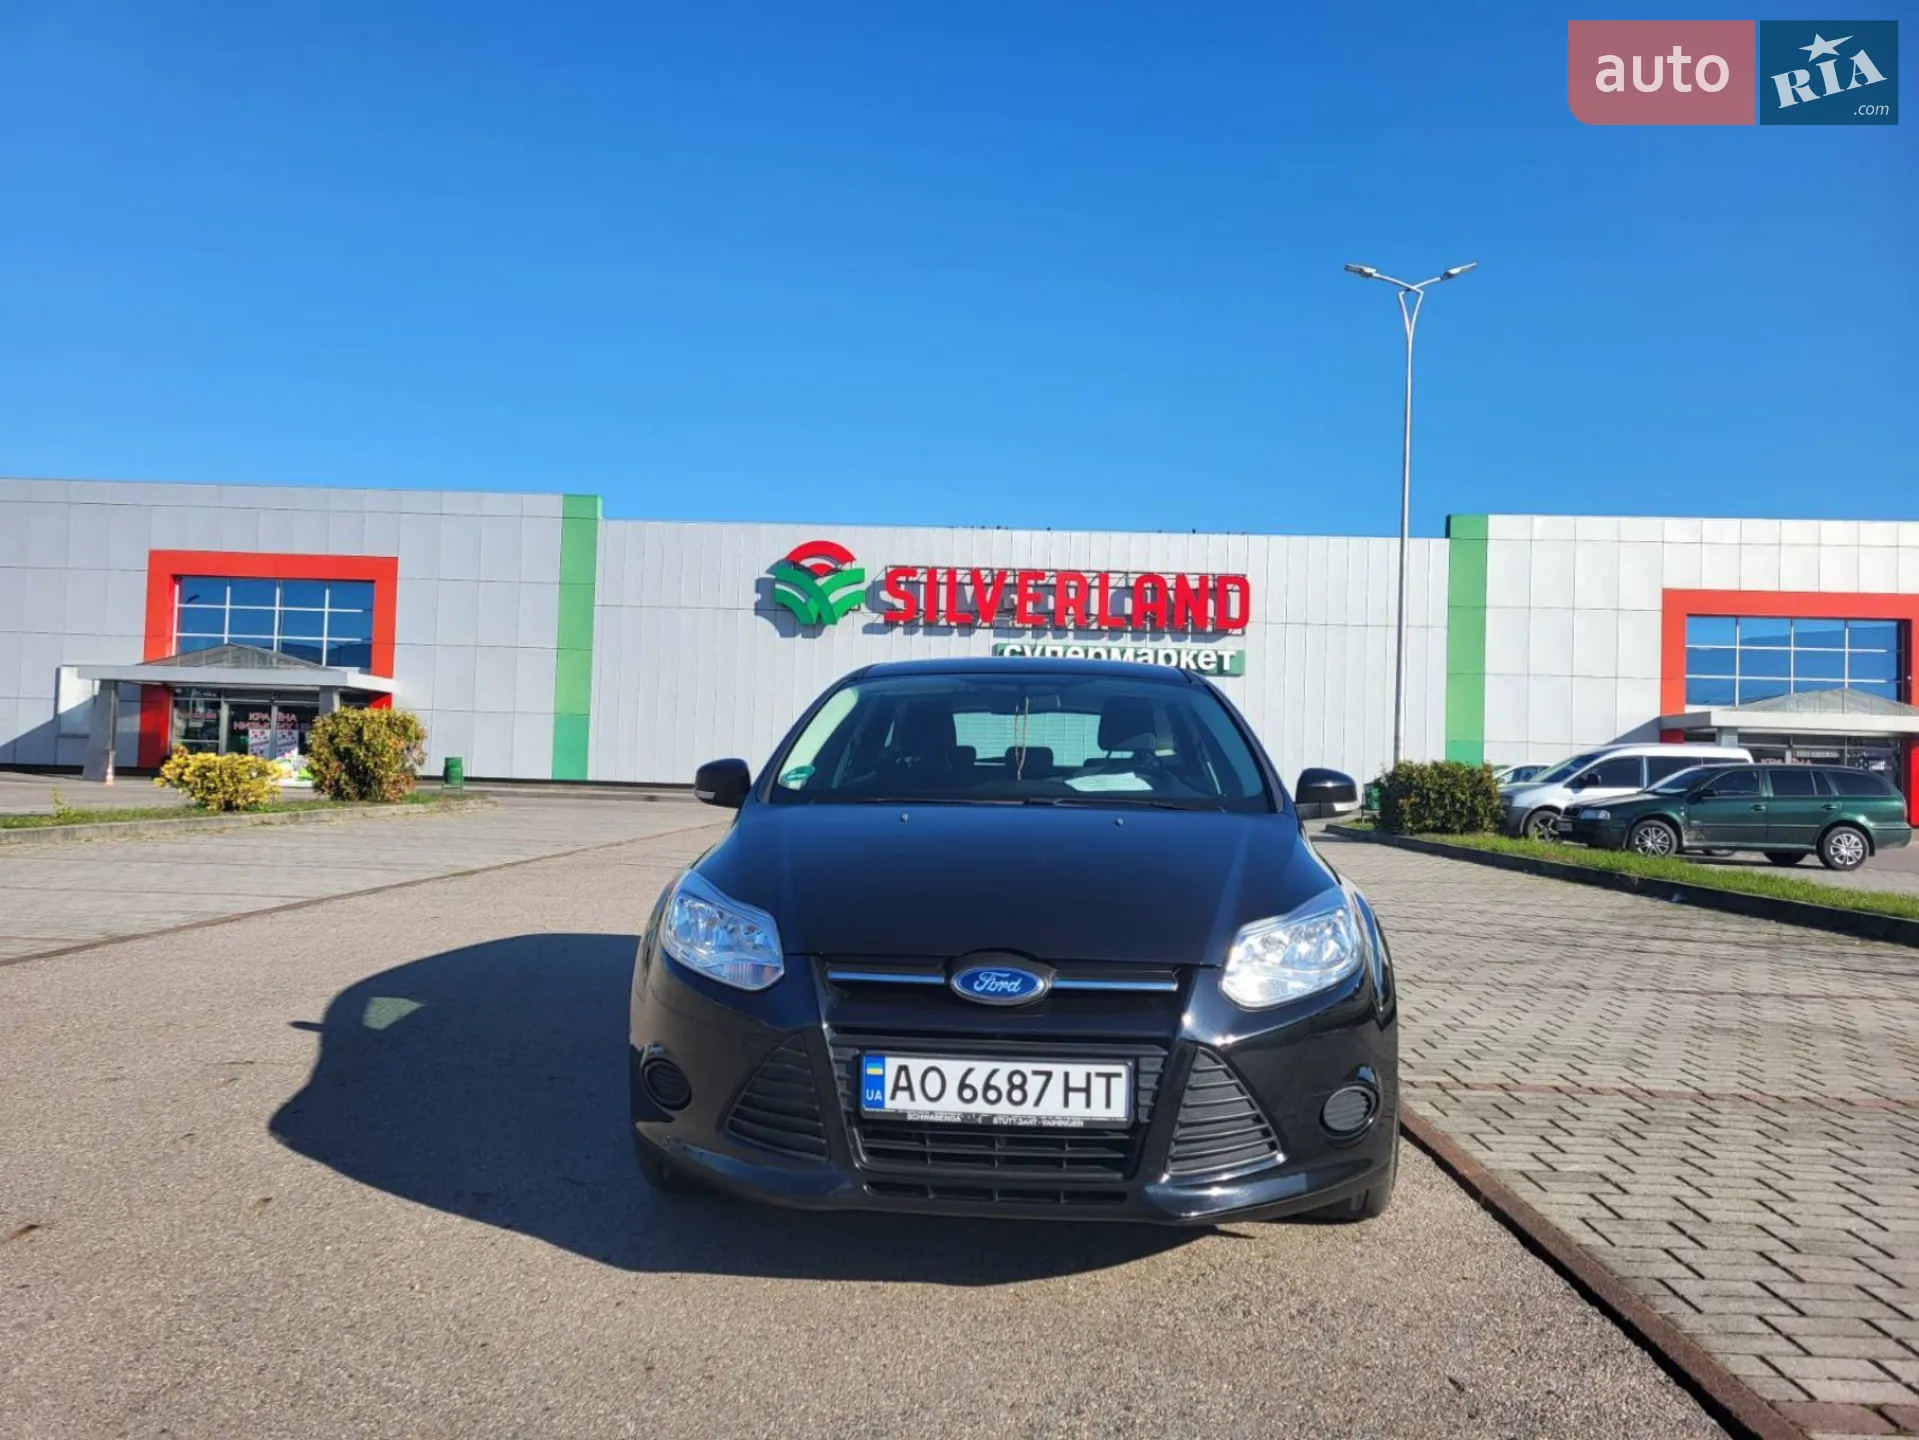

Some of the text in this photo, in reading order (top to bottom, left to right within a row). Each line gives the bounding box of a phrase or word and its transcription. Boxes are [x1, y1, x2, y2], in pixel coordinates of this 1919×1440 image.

[883, 566, 1251, 632] SILVERLAND
[973, 971, 1022, 993] Ford
[866, 1089, 883, 1101] UA
[889, 1064, 1123, 1109] AO 6687 HT
